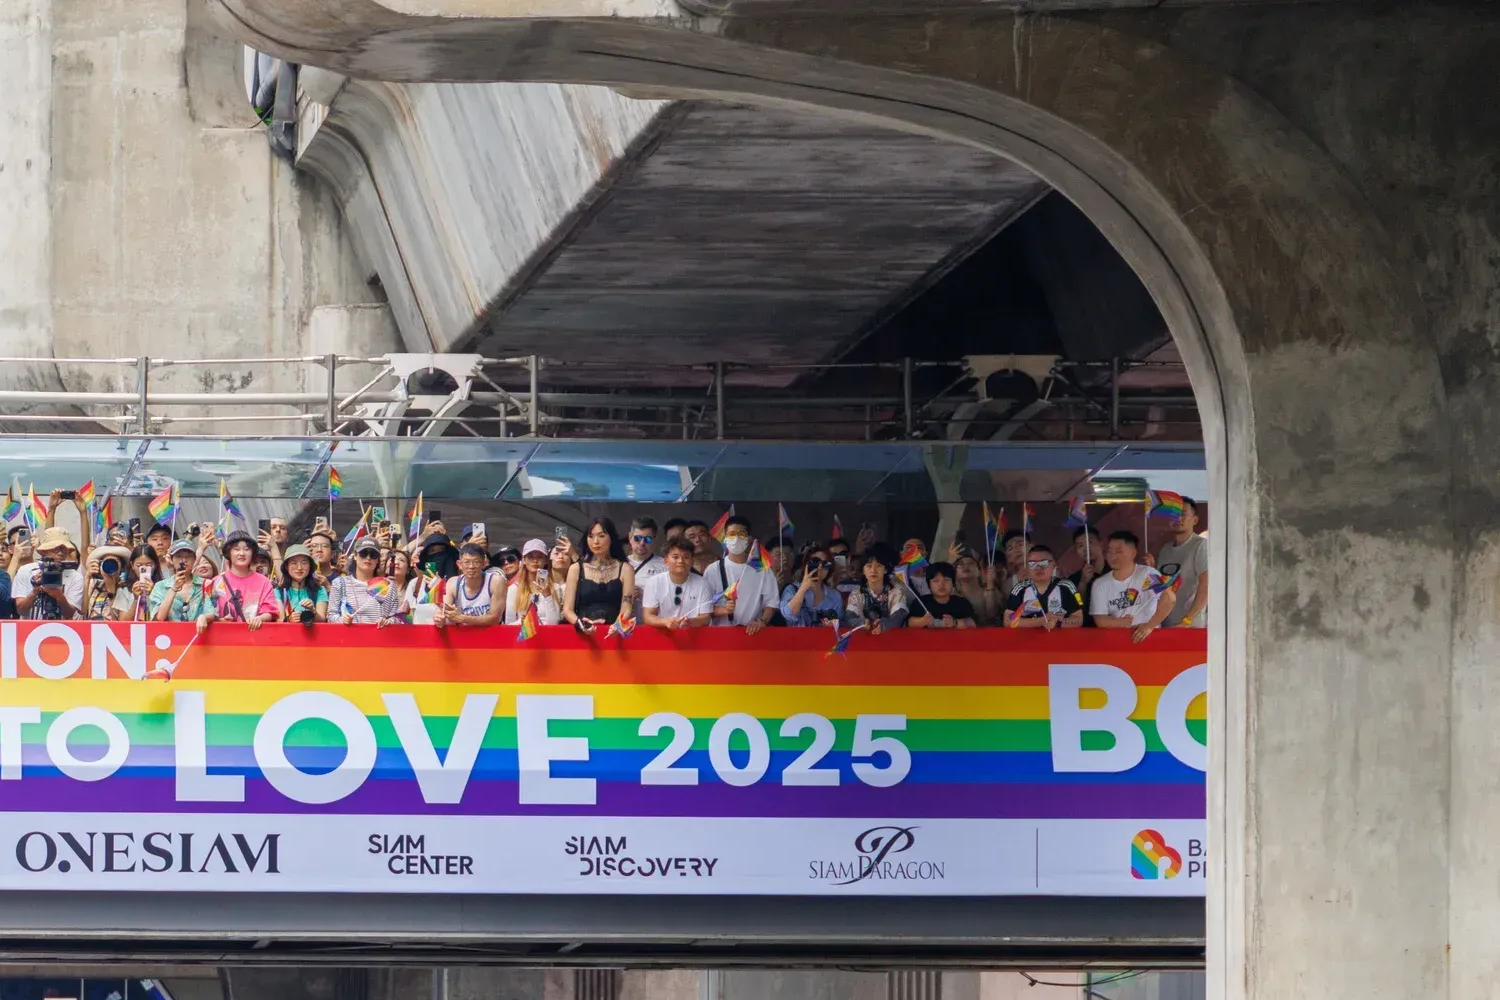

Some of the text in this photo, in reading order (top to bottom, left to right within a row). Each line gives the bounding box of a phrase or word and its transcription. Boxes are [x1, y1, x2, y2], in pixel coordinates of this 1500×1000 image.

[173, 690, 597, 805] LOVE
[638, 711, 912, 787] 2025
[368, 833, 425, 854] SIAM
[564, 835, 627, 855] SIAM
[387, 855, 474, 875] CENTER
[580, 857, 718, 877] DISCOVERY
[809, 855, 946, 880] SIAM PARAGON
